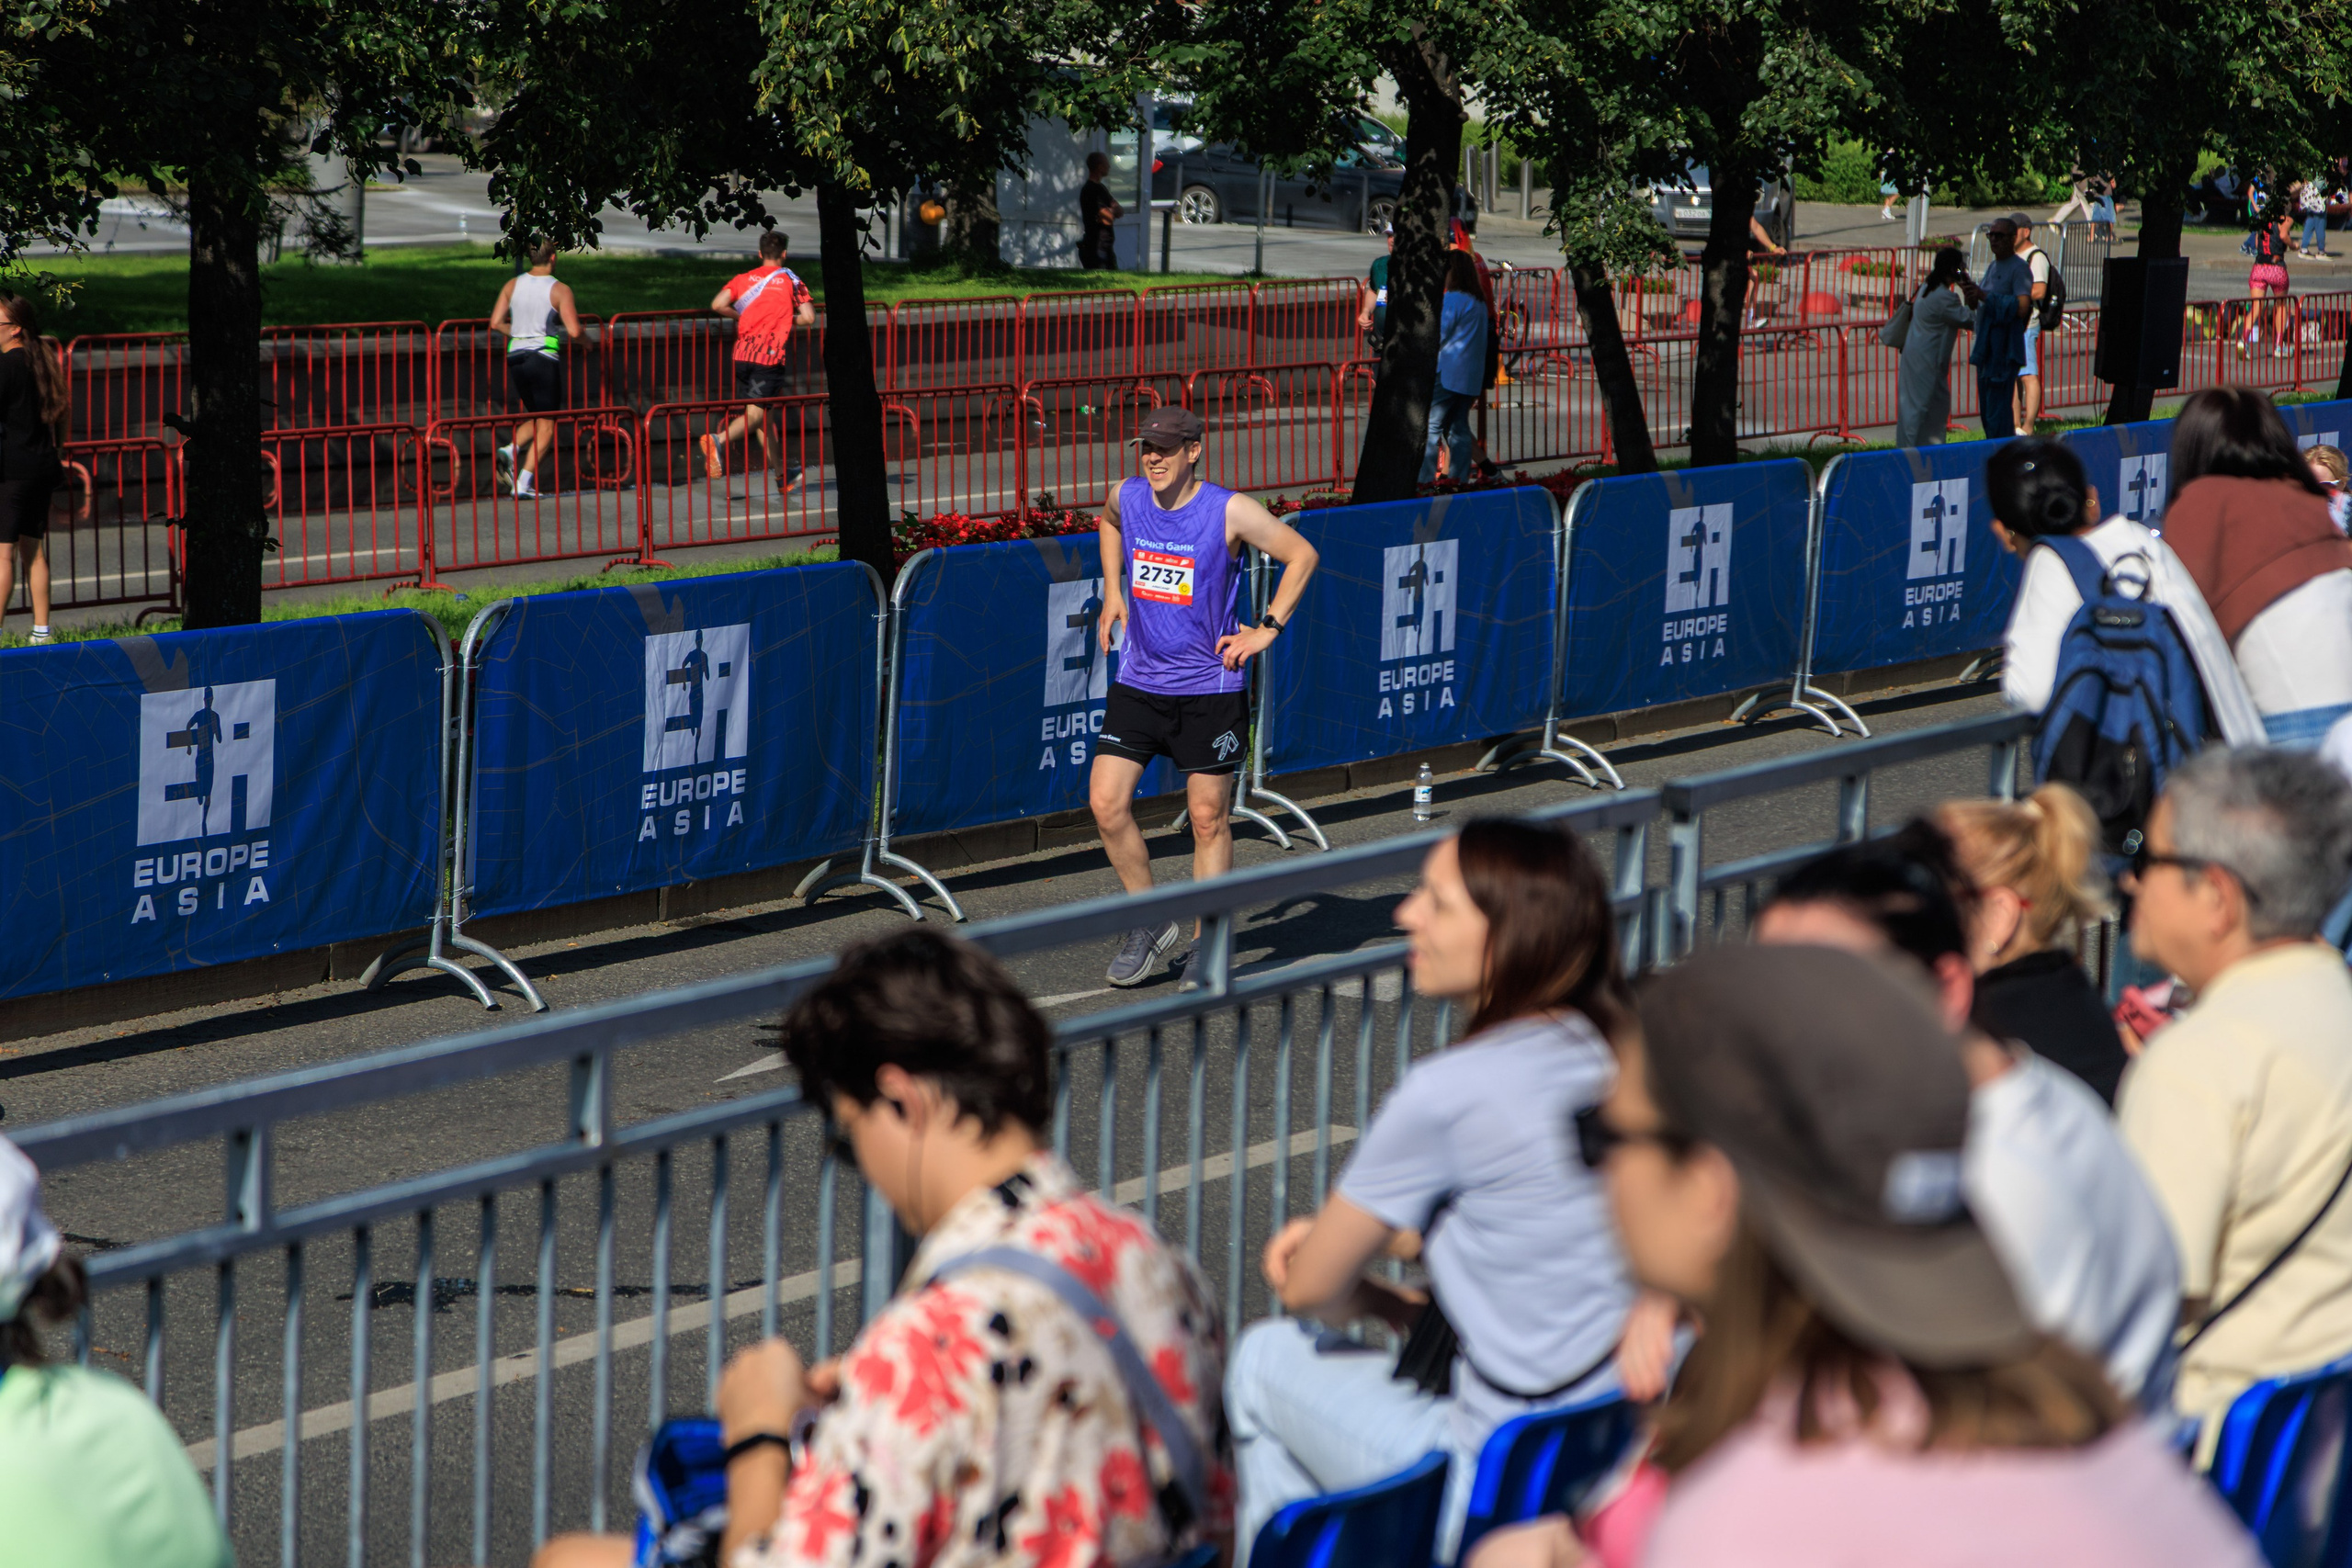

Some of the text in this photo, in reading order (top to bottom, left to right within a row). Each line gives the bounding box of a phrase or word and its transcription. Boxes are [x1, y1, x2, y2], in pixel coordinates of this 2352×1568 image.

[749, 275, 785, 286] Коур
[1135, 537, 1194, 552] точка банк
[1139, 564, 1185, 586] 2737
[1905, 581, 1964, 606] EUROPE
[1662, 613, 1727, 642] EUROPE
[1902, 603, 1961, 629] ASIA
[1659, 637, 1725, 666] ASIA
[1379, 660, 1454, 692] EUROPE
[1377, 687, 1455, 719] ASIA
[1041, 709, 1106, 741] EURO
[1038, 740, 1087, 771] AS
[640, 768, 746, 810] EUROPE
[639, 800, 744, 842] ASIA
[134, 840, 269, 888] EUROPE
[130, 875, 270, 924] ASIA
